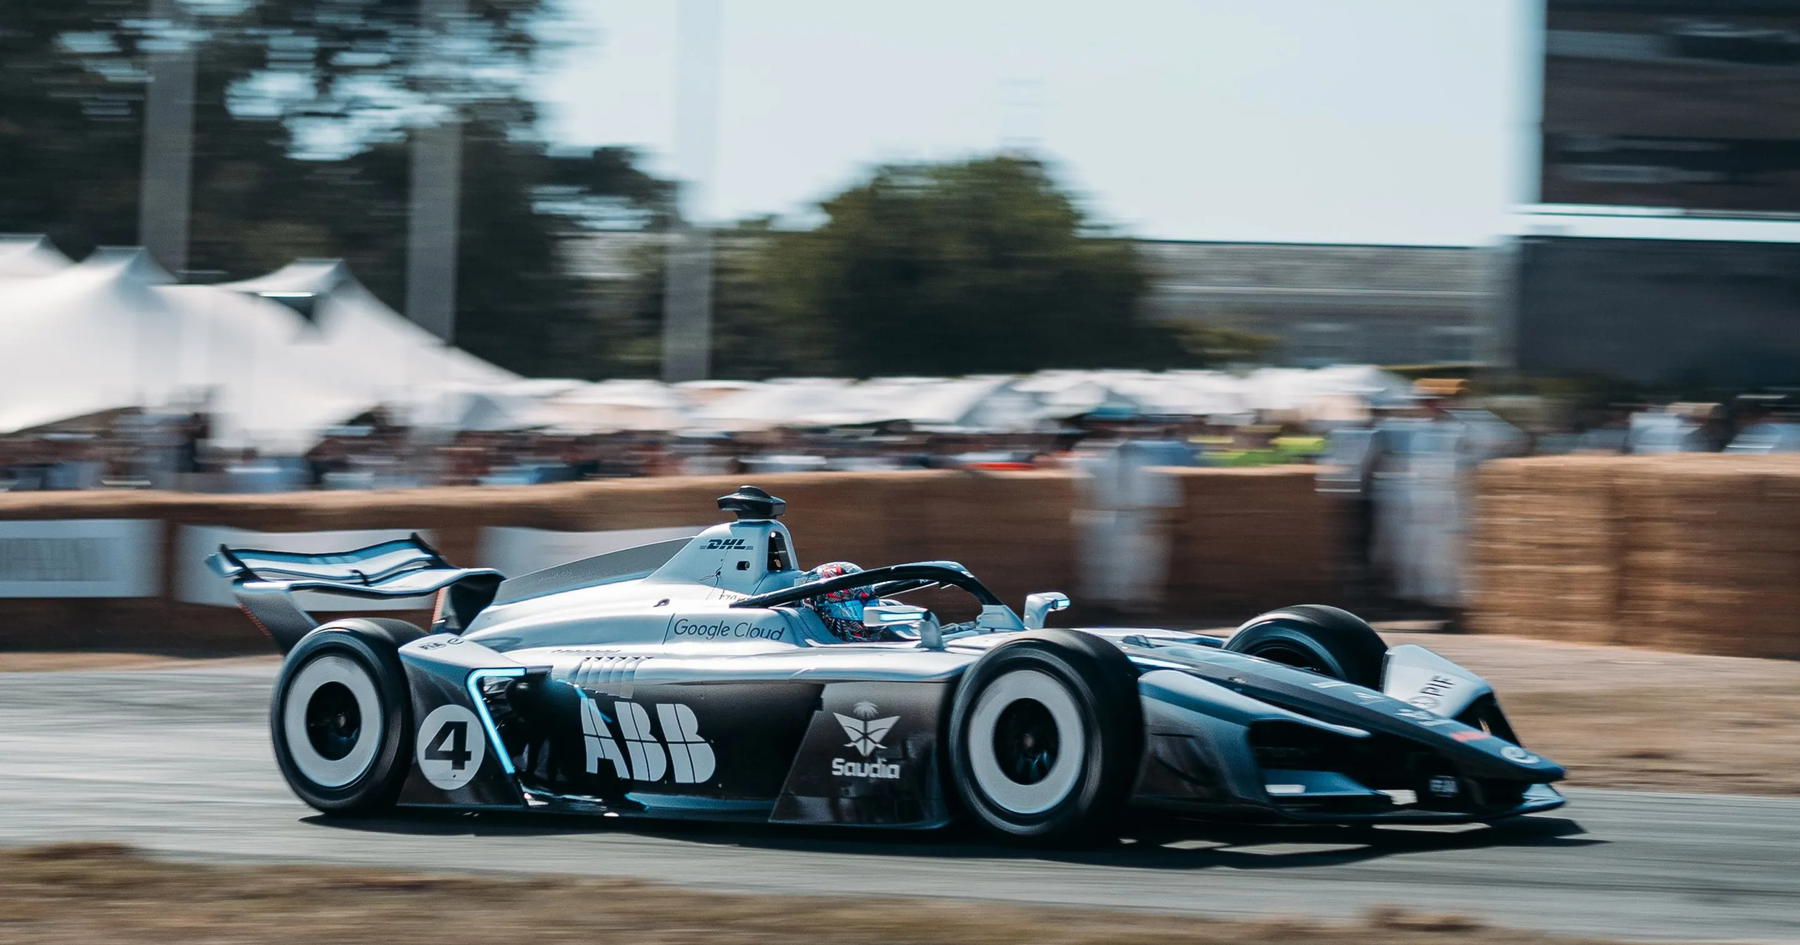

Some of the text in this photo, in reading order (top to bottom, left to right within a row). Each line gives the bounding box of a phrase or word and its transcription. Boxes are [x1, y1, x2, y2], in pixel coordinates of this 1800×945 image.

[706, 538, 747, 550] DHL
[674, 618, 785, 641] Google Cloud
[424, 720, 473, 770] 4
[581, 698, 716, 784] ABB
[831, 757, 900, 779] Saudia
